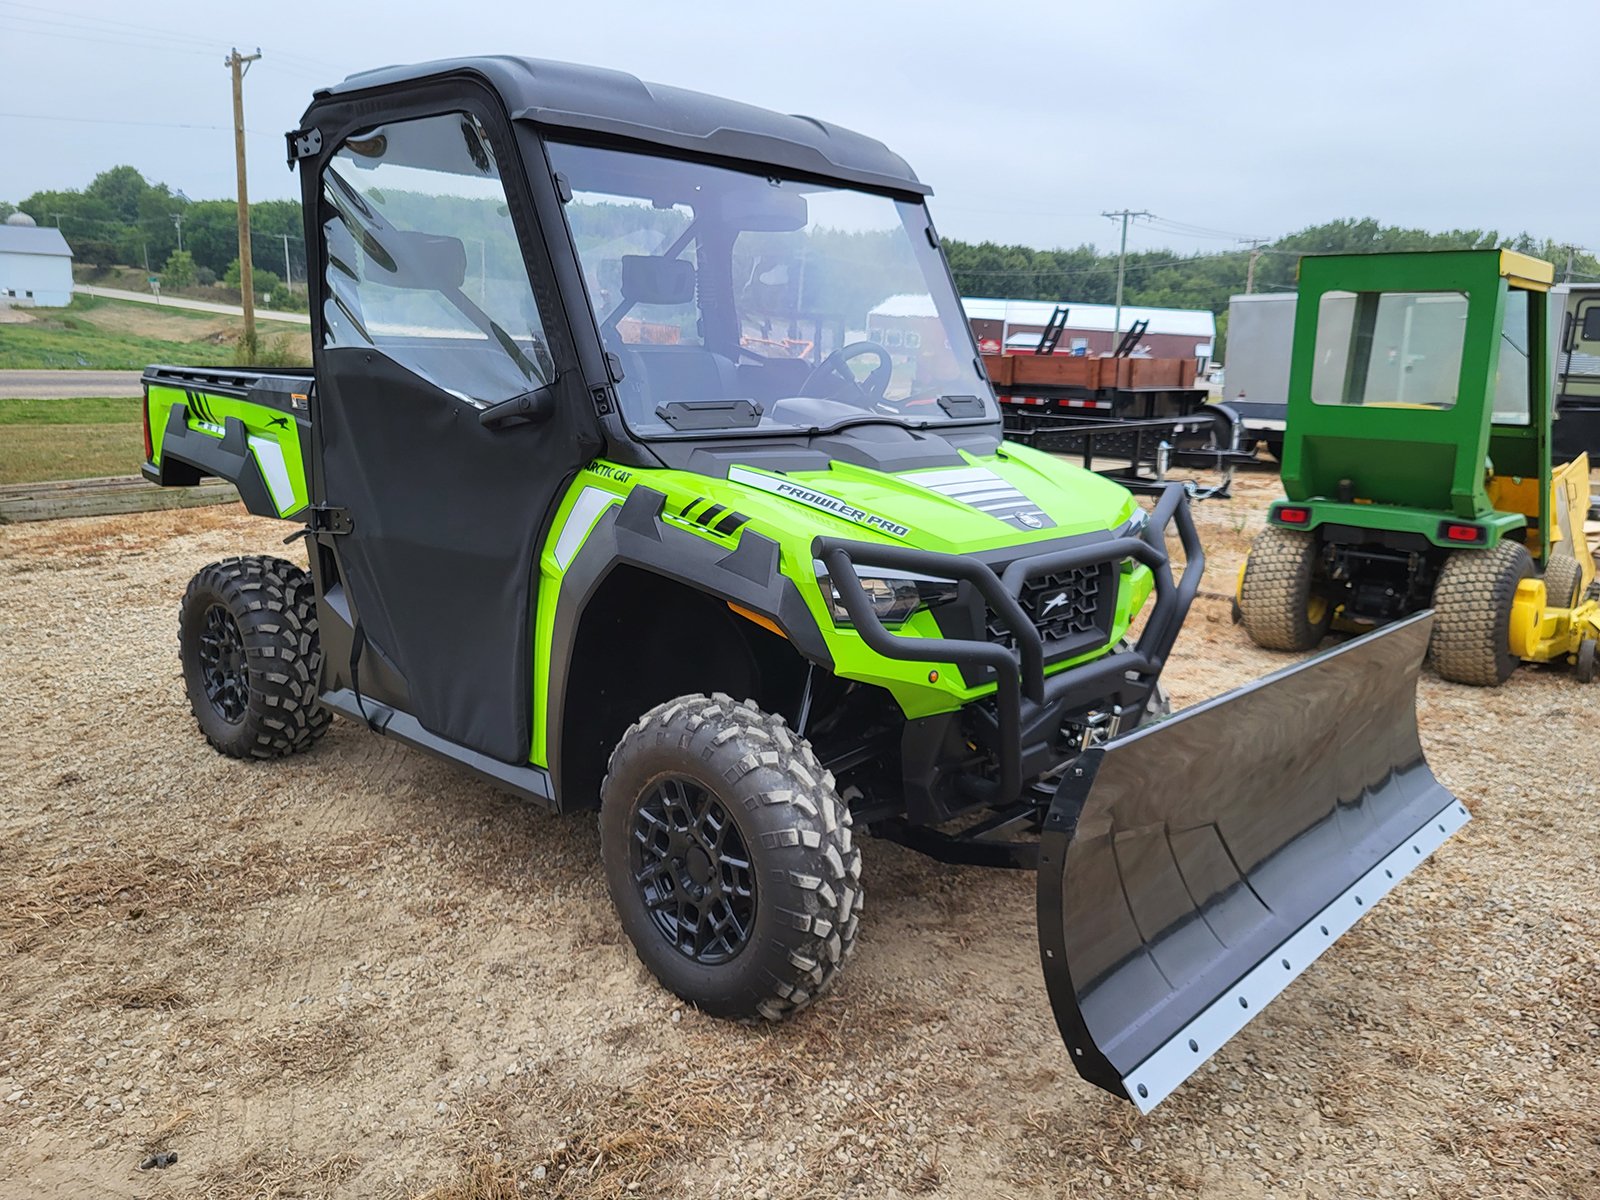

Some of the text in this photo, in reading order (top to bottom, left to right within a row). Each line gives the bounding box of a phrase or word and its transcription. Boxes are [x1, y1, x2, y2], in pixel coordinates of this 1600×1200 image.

[584, 461, 633, 483] ARCTIC CAT
[776, 484, 909, 536] PROWLER PRO
